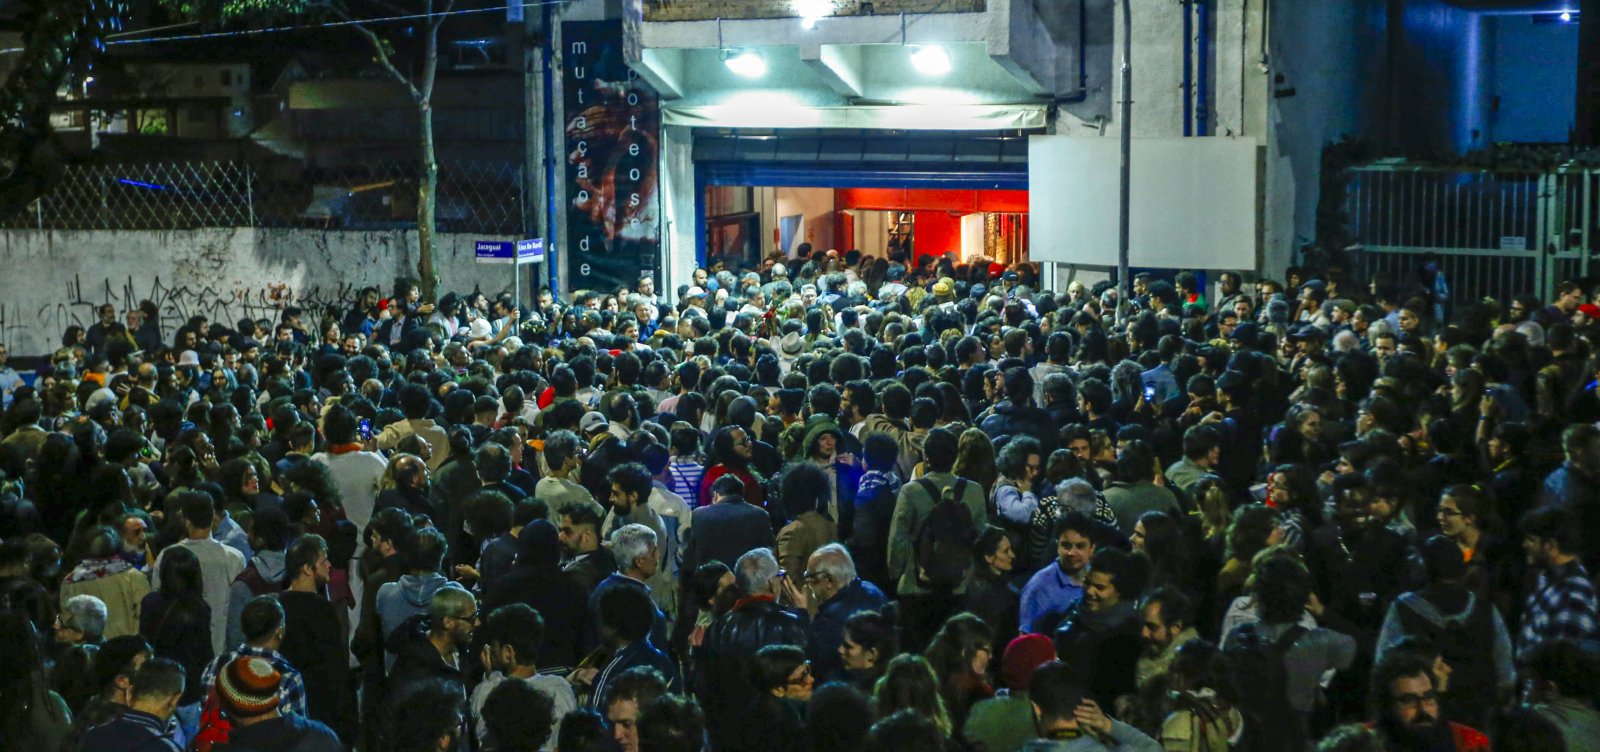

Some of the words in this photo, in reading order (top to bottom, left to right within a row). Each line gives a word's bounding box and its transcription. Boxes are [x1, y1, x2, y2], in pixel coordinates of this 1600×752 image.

[572, 41, 588, 200] mutação
[627, 68, 641, 229] poteose
[477, 243, 501, 252] Jaceguai
[579, 235, 591, 276] de
